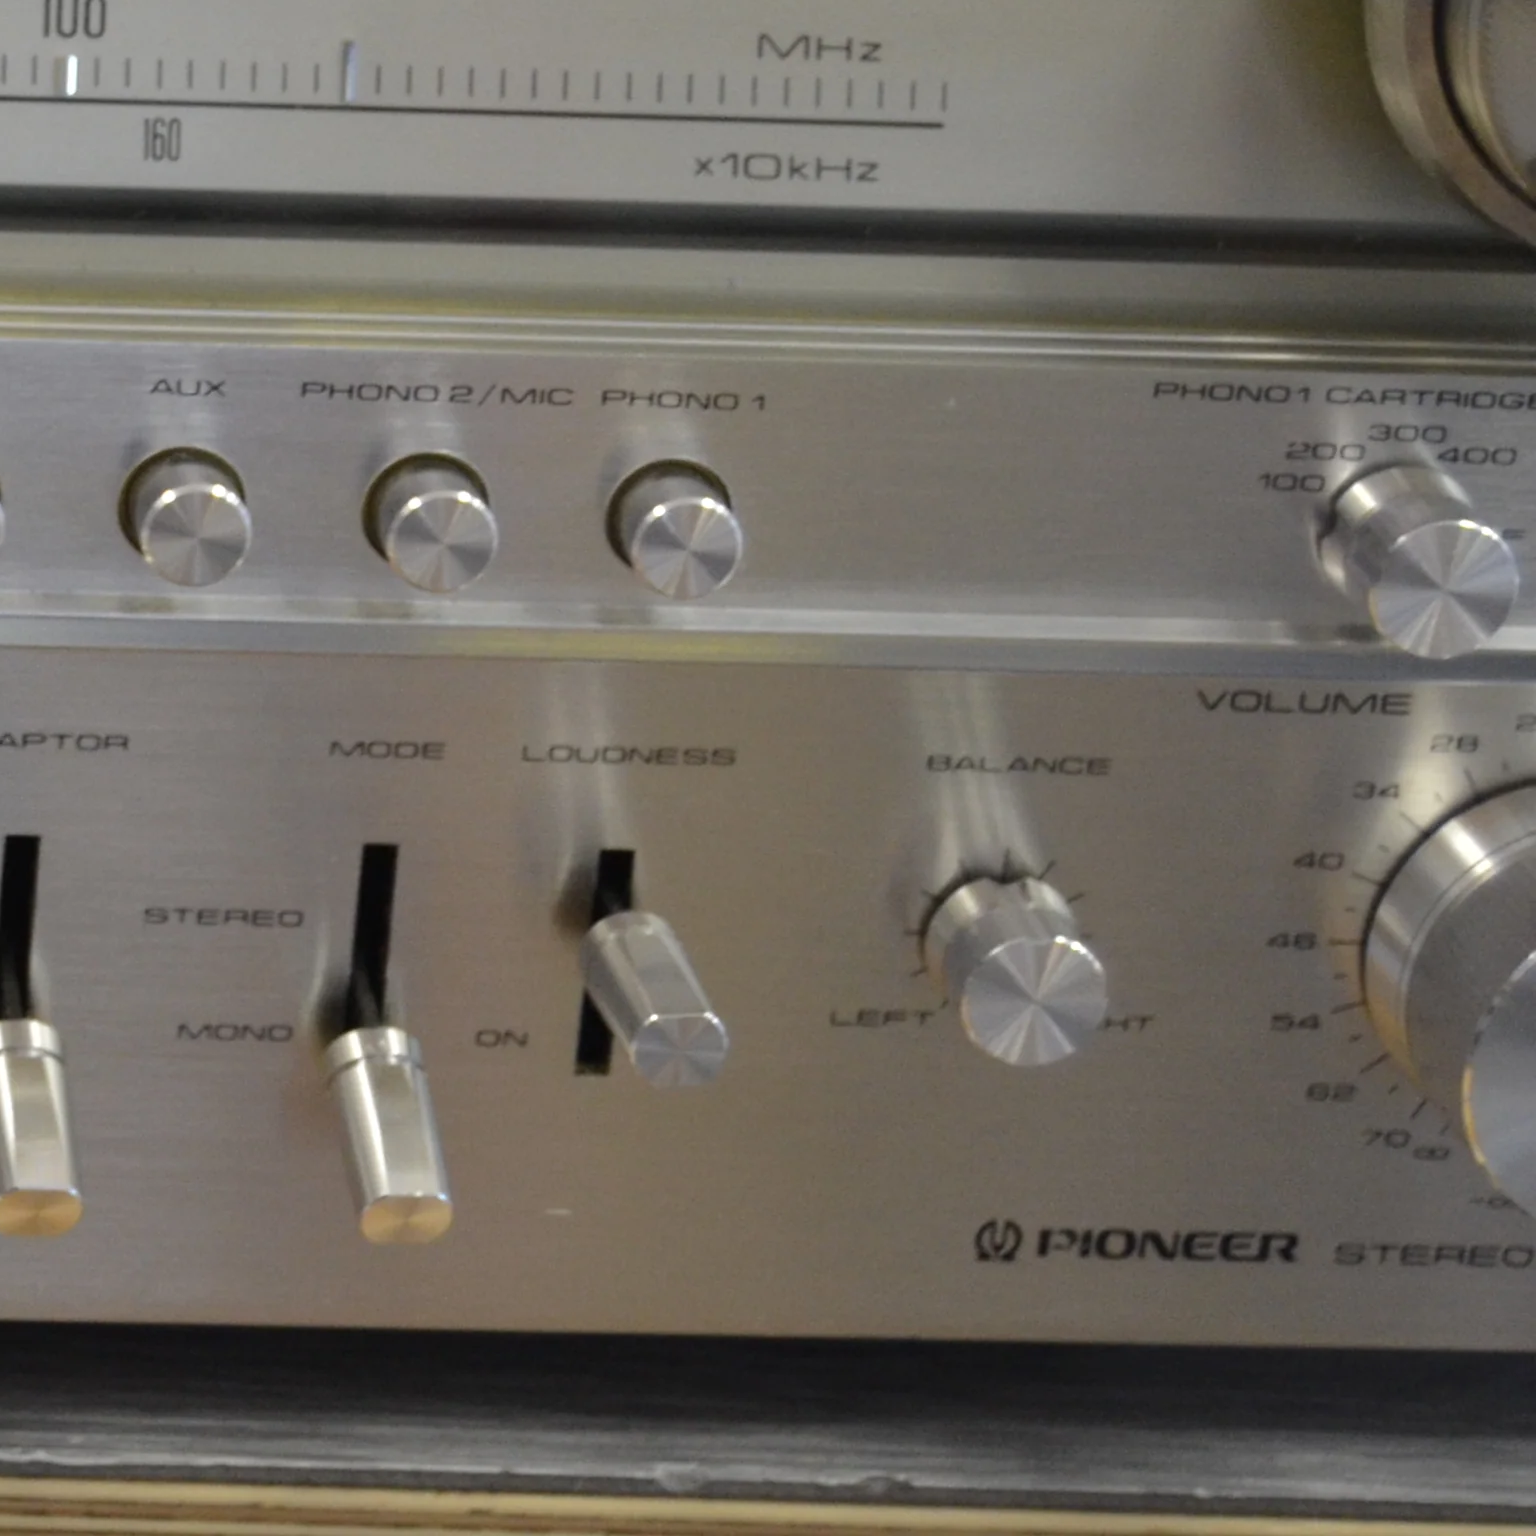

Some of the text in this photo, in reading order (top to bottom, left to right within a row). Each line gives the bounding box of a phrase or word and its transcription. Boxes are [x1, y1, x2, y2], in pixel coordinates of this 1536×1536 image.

[757, 33, 882, 62] MHz
[143, 118, 181, 162] 160
[150, 377, 226, 396] AUX
[601, 389, 740, 411] PHONO
[1258, 424, 1518, 493] 100 200 300 400
[1197, 688, 1413, 716] VOLUME
[330, 741, 446, 760] MODE
[521, 744, 737, 766] LOUDNESS
[925, 755, 1114, 776] BALANCE
[1292, 851, 1346, 871] 40
[1352, 780, 1400, 800] 34
[1429, 734, 1481, 753] 28
[1515, 713, 1536, 732] 2
[143, 907, 306, 929] STEREO
[829, 1009, 935, 1028] LEFT
[177, 1023, 294, 1042] MONO
[474, 1029, 528, 1049] ON
[1362, 1128, 1411, 1149] 70
[1036, 1228, 1534, 1270] PIONEER STEREO
